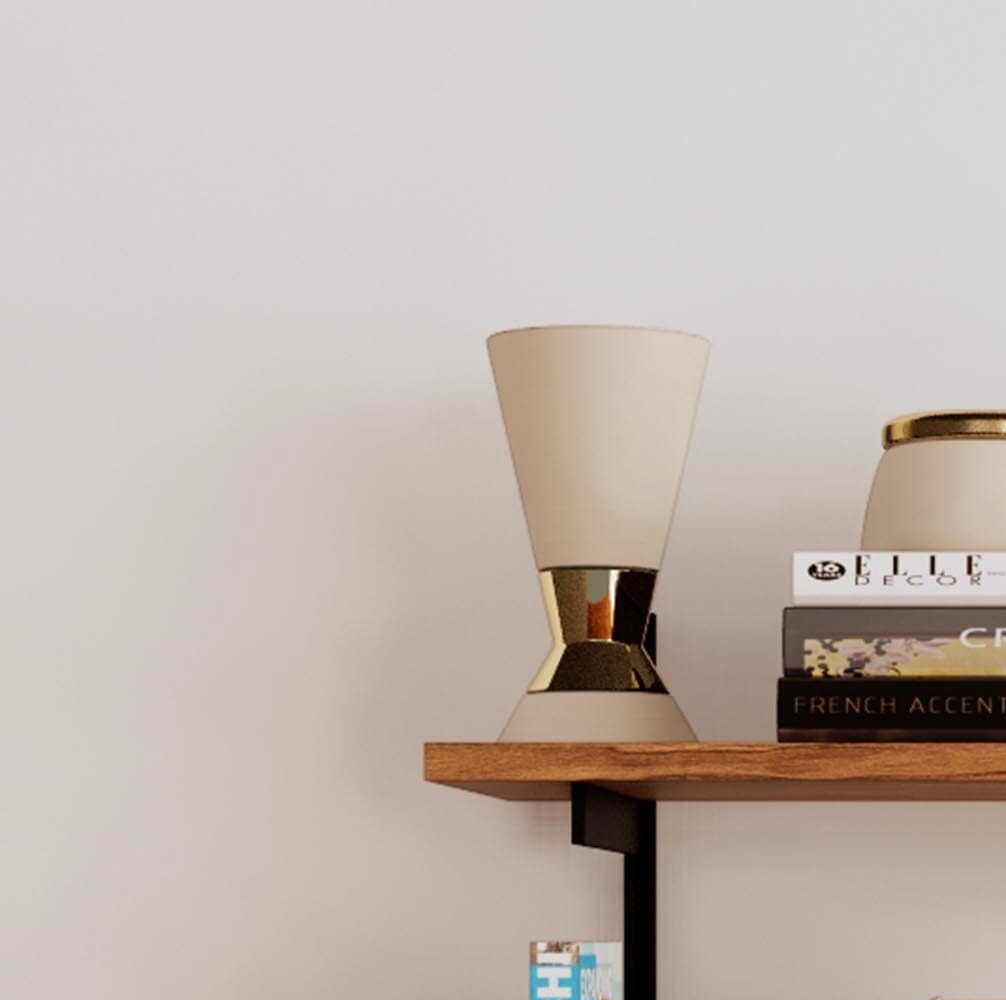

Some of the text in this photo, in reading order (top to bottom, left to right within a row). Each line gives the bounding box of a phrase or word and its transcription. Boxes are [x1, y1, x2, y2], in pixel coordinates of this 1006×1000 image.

[855, 554, 983, 576] ELLE
[855, 575, 982, 586] DECOR
[793, 696, 897, 715] FRENCH
